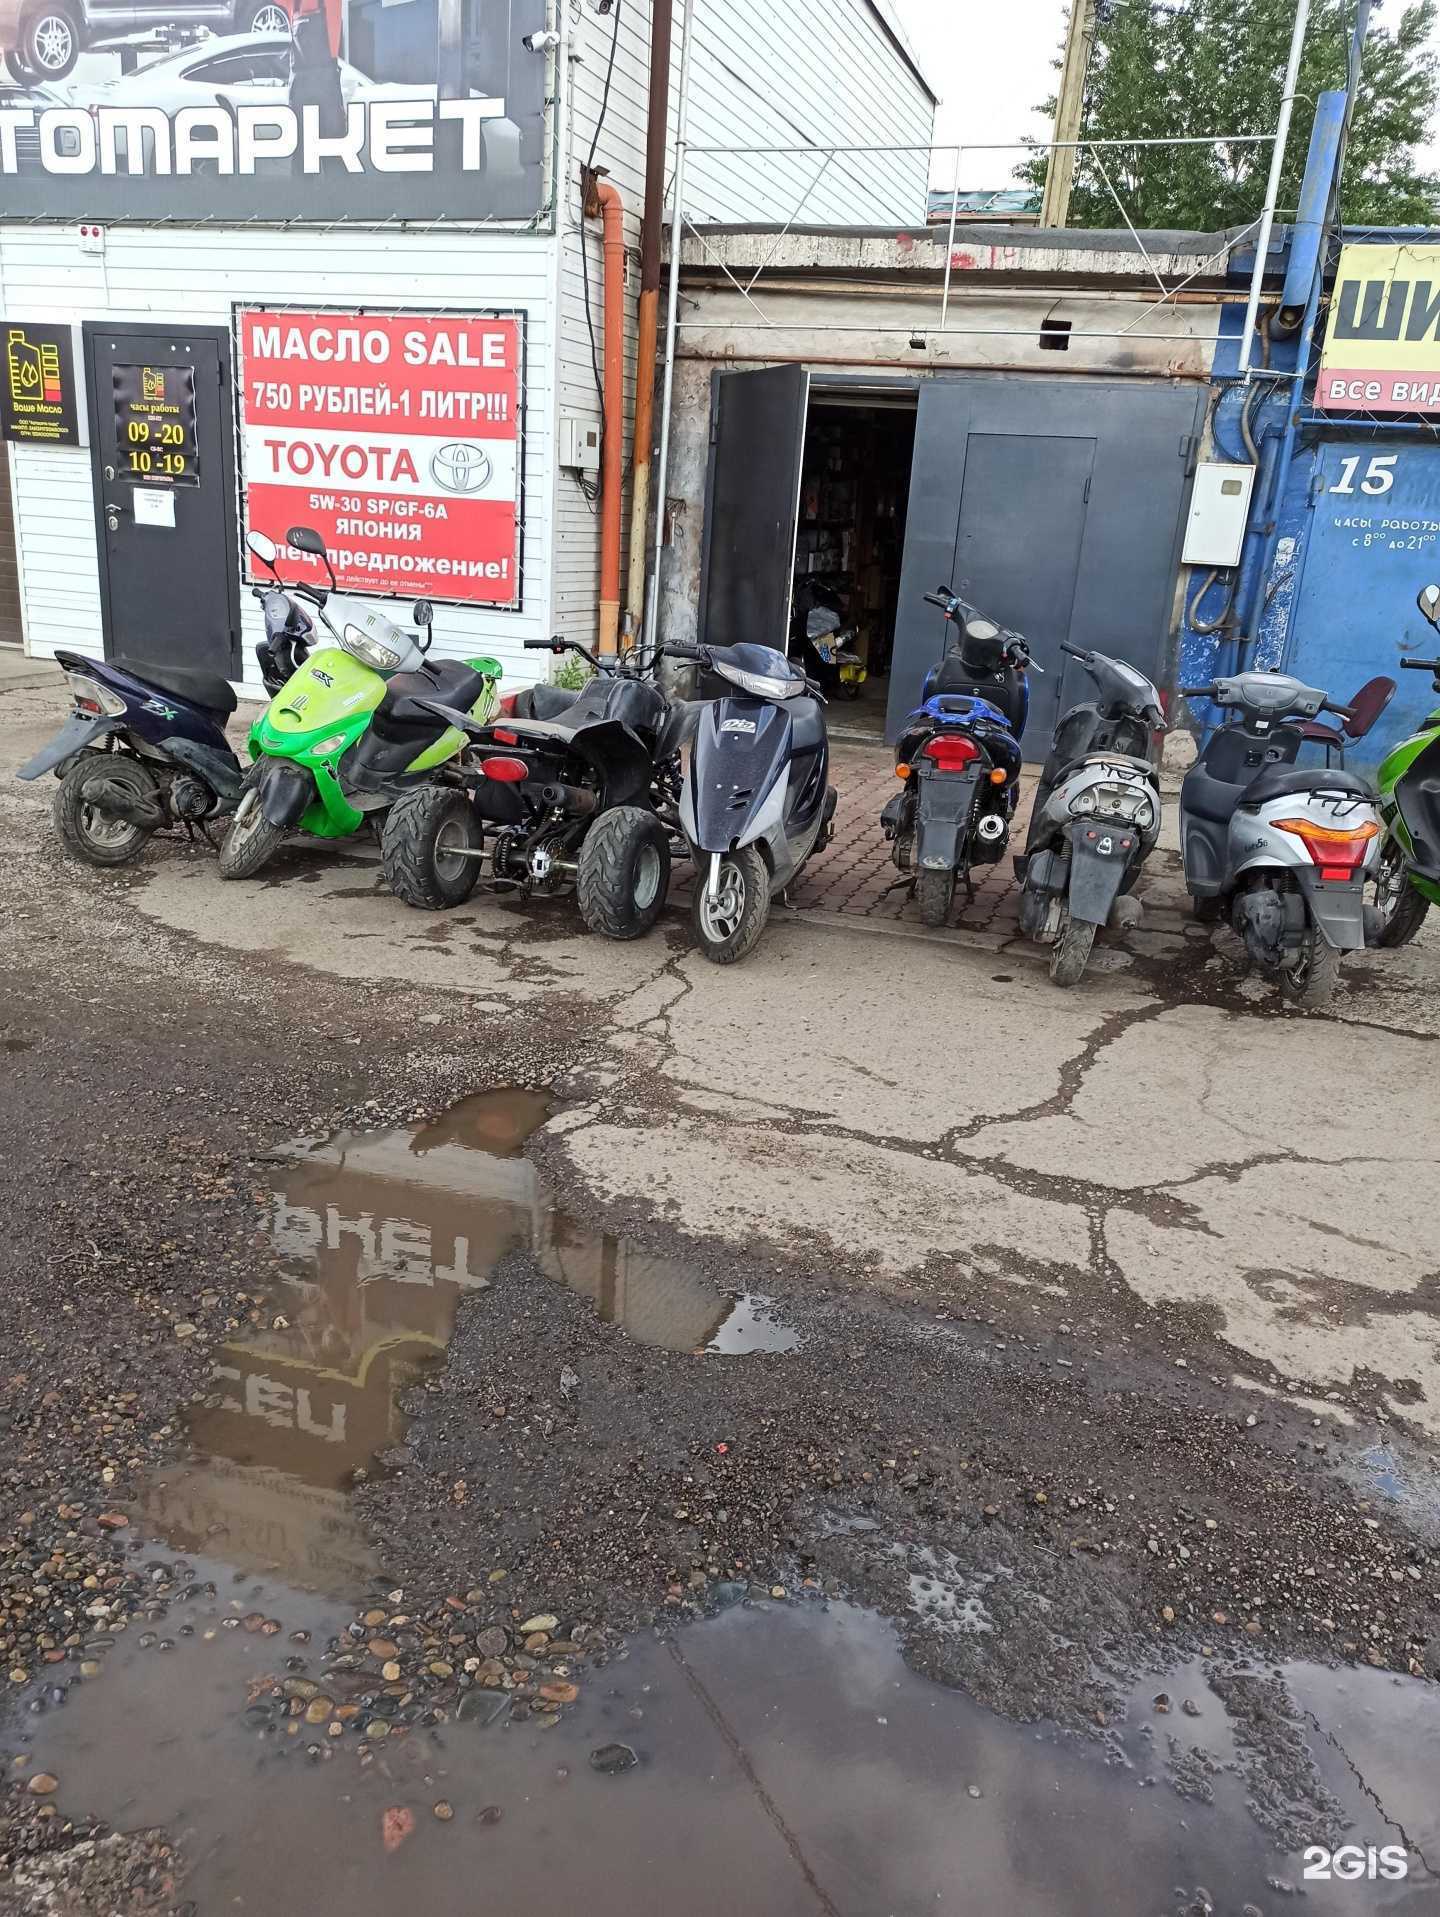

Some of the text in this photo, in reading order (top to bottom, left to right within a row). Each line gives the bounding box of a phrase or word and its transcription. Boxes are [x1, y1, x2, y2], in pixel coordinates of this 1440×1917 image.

[252, 326, 506, 368] МАСЛО SALE
[252, 381, 508, 421] 750 РУБЛЕЙ-1 ЛИТР!!!
[128, 422, 149, 442] 09
[129, 451, 151, 472] 10
[264, 439, 420, 483] TOYOTA
[1329, 455, 1399, 495] 15
[309, 494, 448, 519] 5W-30 SP/GF-6A
[335, 518, 422, 541] ЯПОНИЯ
[270, 541, 509, 579] пец-предложение!
